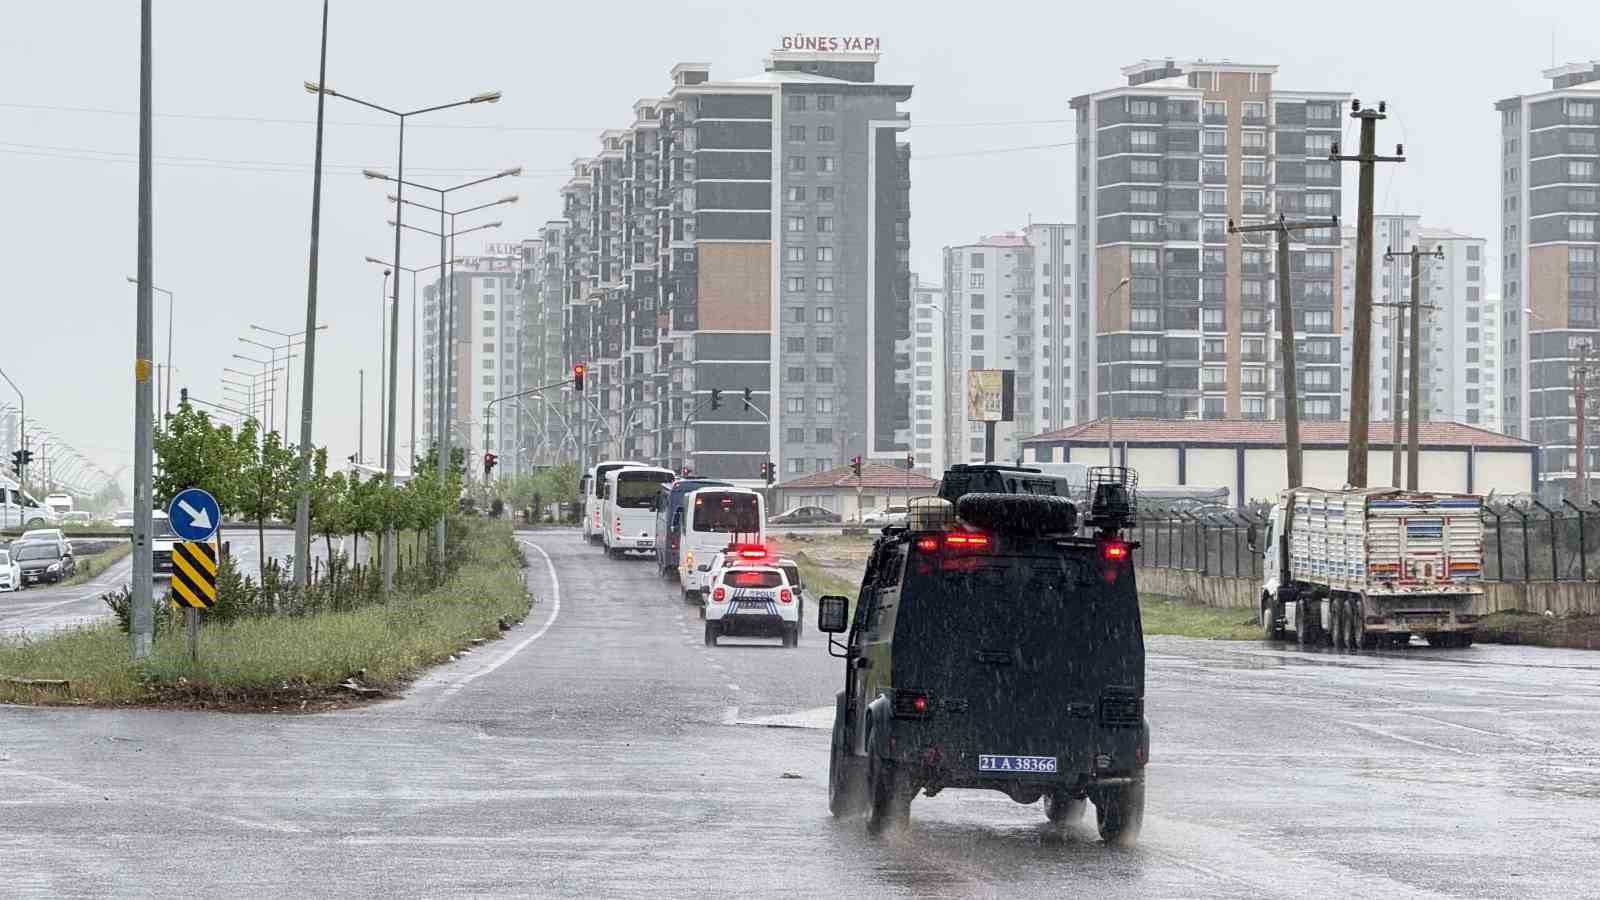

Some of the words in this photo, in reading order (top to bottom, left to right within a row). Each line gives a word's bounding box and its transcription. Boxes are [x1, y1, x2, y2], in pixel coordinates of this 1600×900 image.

[843, 36, 880, 50] YAPI
[982, 757, 997, 769] 21
[1001, 757, 1011, 769] A
[1015, 758, 1055, 771] 38366
